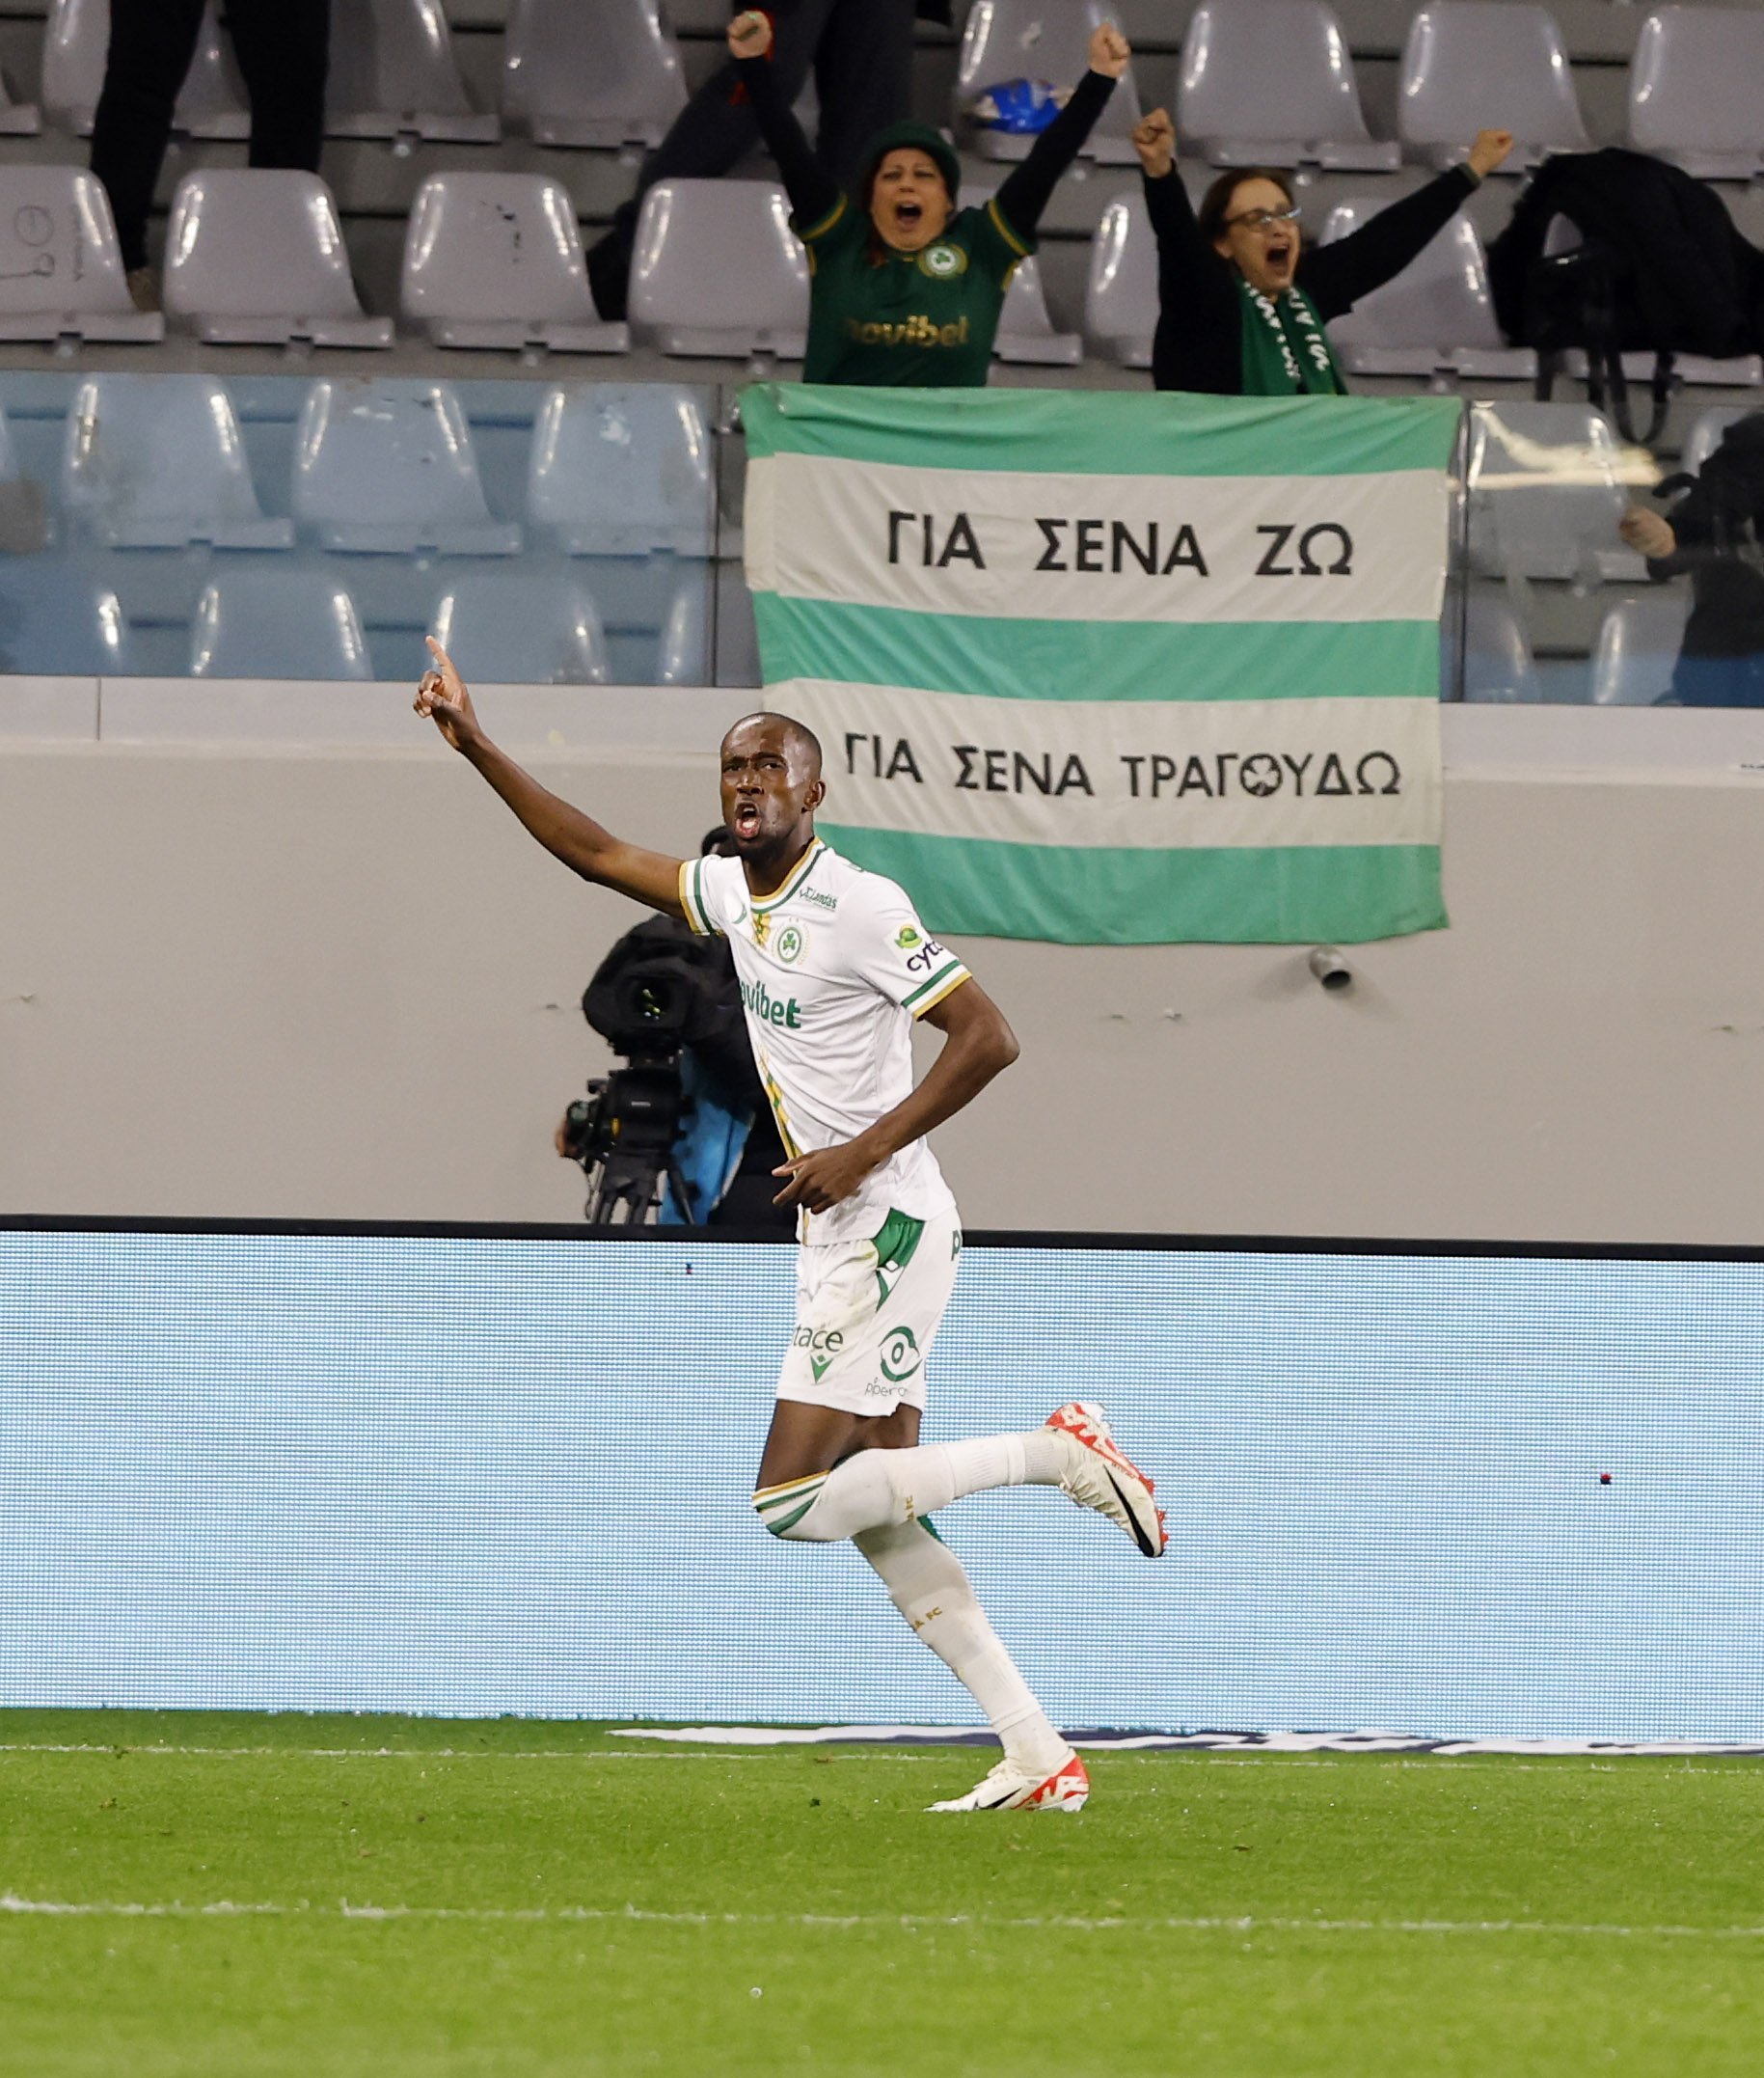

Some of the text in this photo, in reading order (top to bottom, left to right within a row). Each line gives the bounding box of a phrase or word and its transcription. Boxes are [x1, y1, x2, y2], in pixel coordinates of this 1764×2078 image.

[887, 510, 1354, 579] ΓΙΑ ΣΕΝΑ ΖΩ
[844, 731, 1402, 799] ΓΙΑ ΣΕΝΑ ΤΡΑΓΟΥΔΩ
